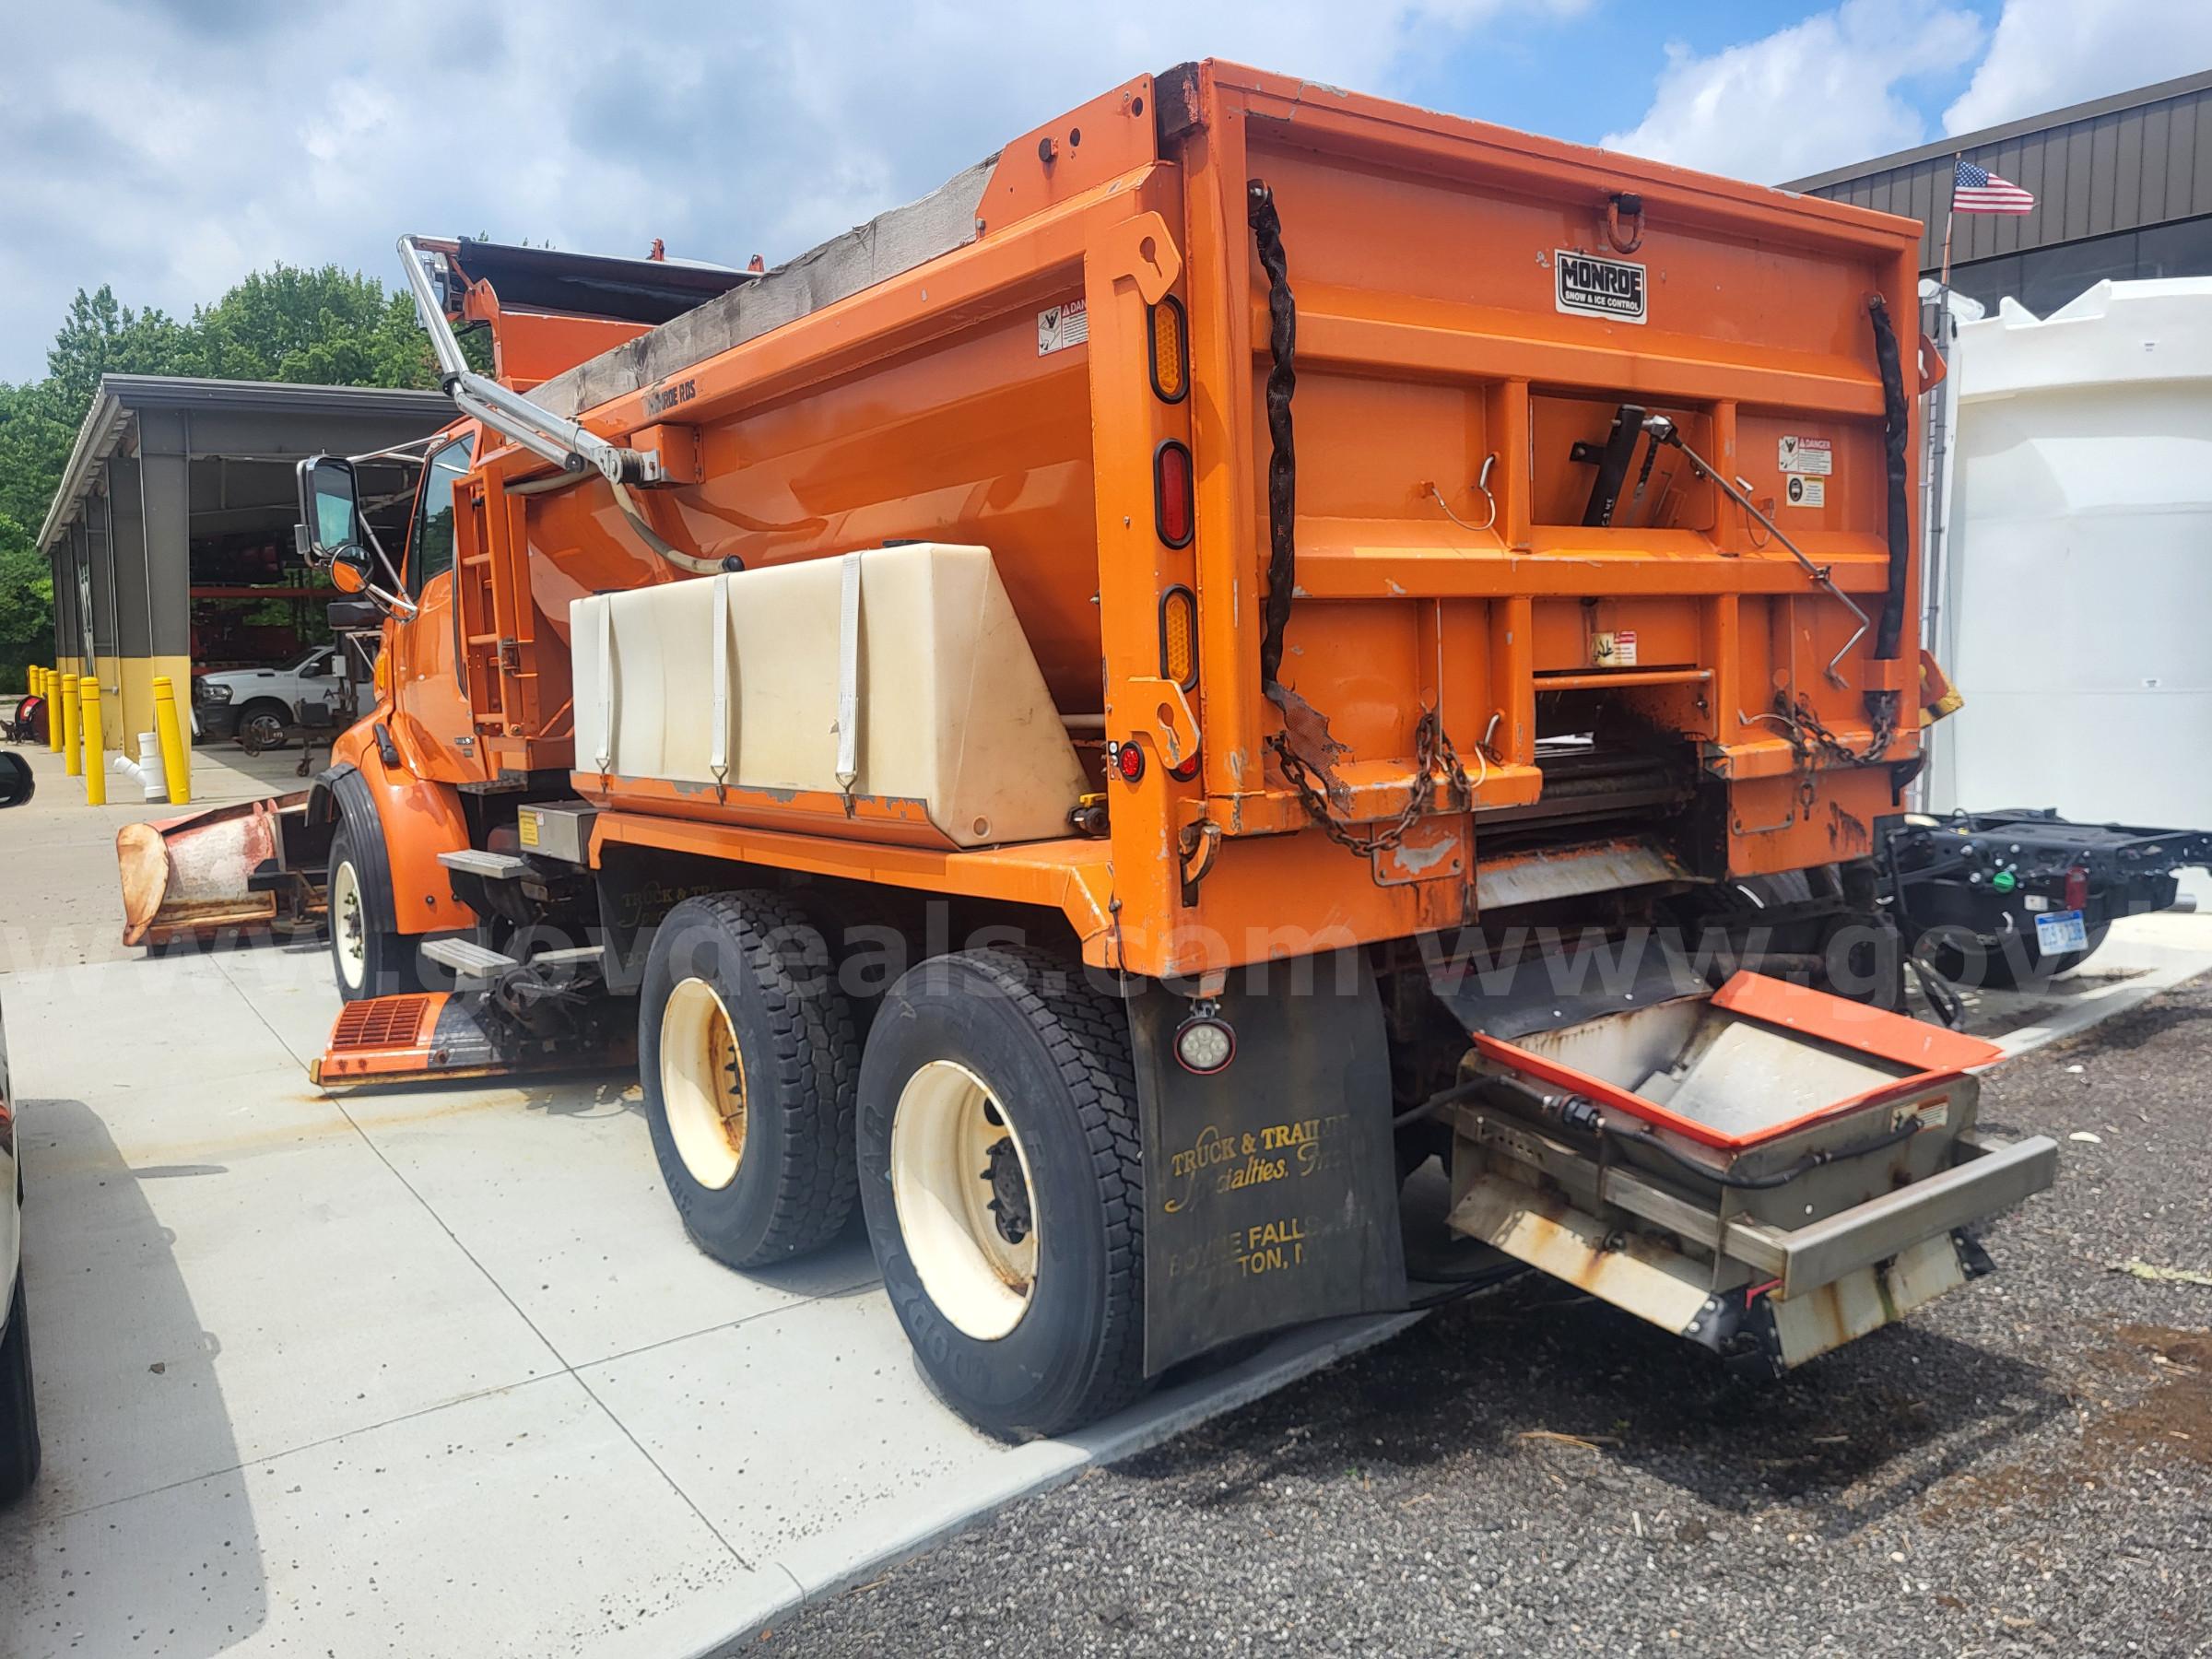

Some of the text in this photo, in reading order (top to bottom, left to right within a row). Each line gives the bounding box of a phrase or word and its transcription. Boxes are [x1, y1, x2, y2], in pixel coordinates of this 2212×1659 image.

[1561, 258, 1641, 297] MONROE
[1565, 290, 1585, 302] SNOW
[1594, 295, 1606, 305] ICE
[1607, 298, 1639, 311] CONTROL
[1171, 1136, 1237, 1177] TRUCK
[1241, 1133, 1257, 1155] &
[1248, 1217, 1319, 1250] FALL
